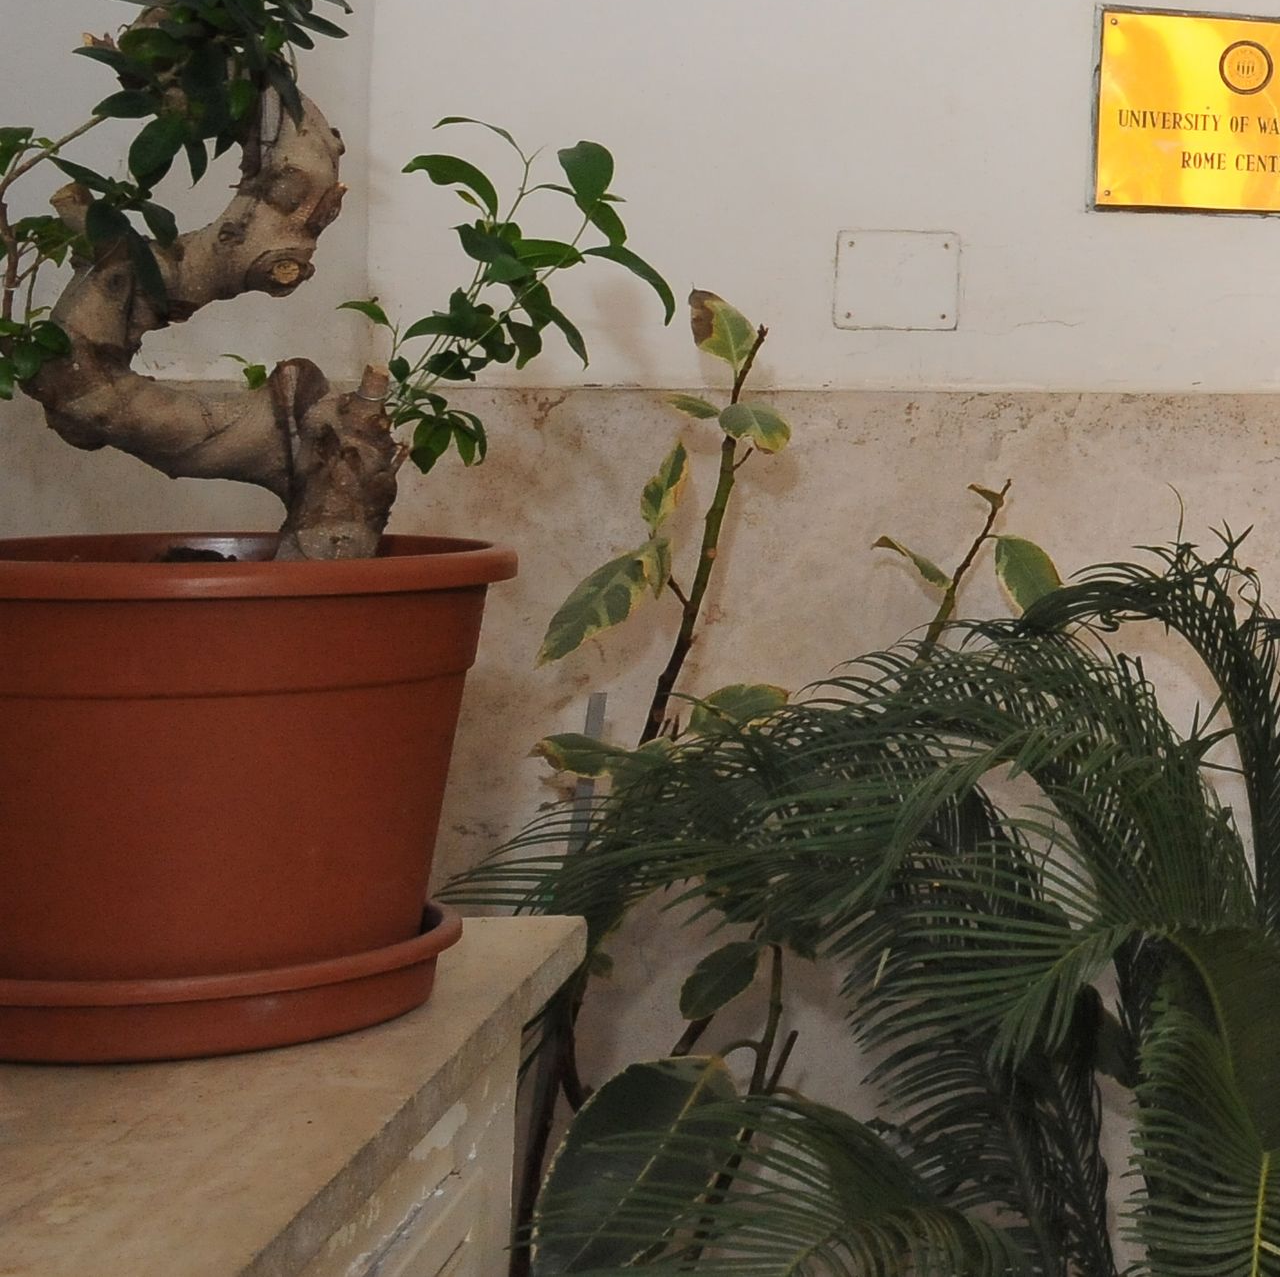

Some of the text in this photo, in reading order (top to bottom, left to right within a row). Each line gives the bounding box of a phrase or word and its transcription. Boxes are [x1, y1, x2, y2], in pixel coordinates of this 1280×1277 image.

[1117, 108, 1221, 133] UNIVERSITY
[1229, 115, 1250, 133] OF
[1180, 150, 1227, 171] ROME
